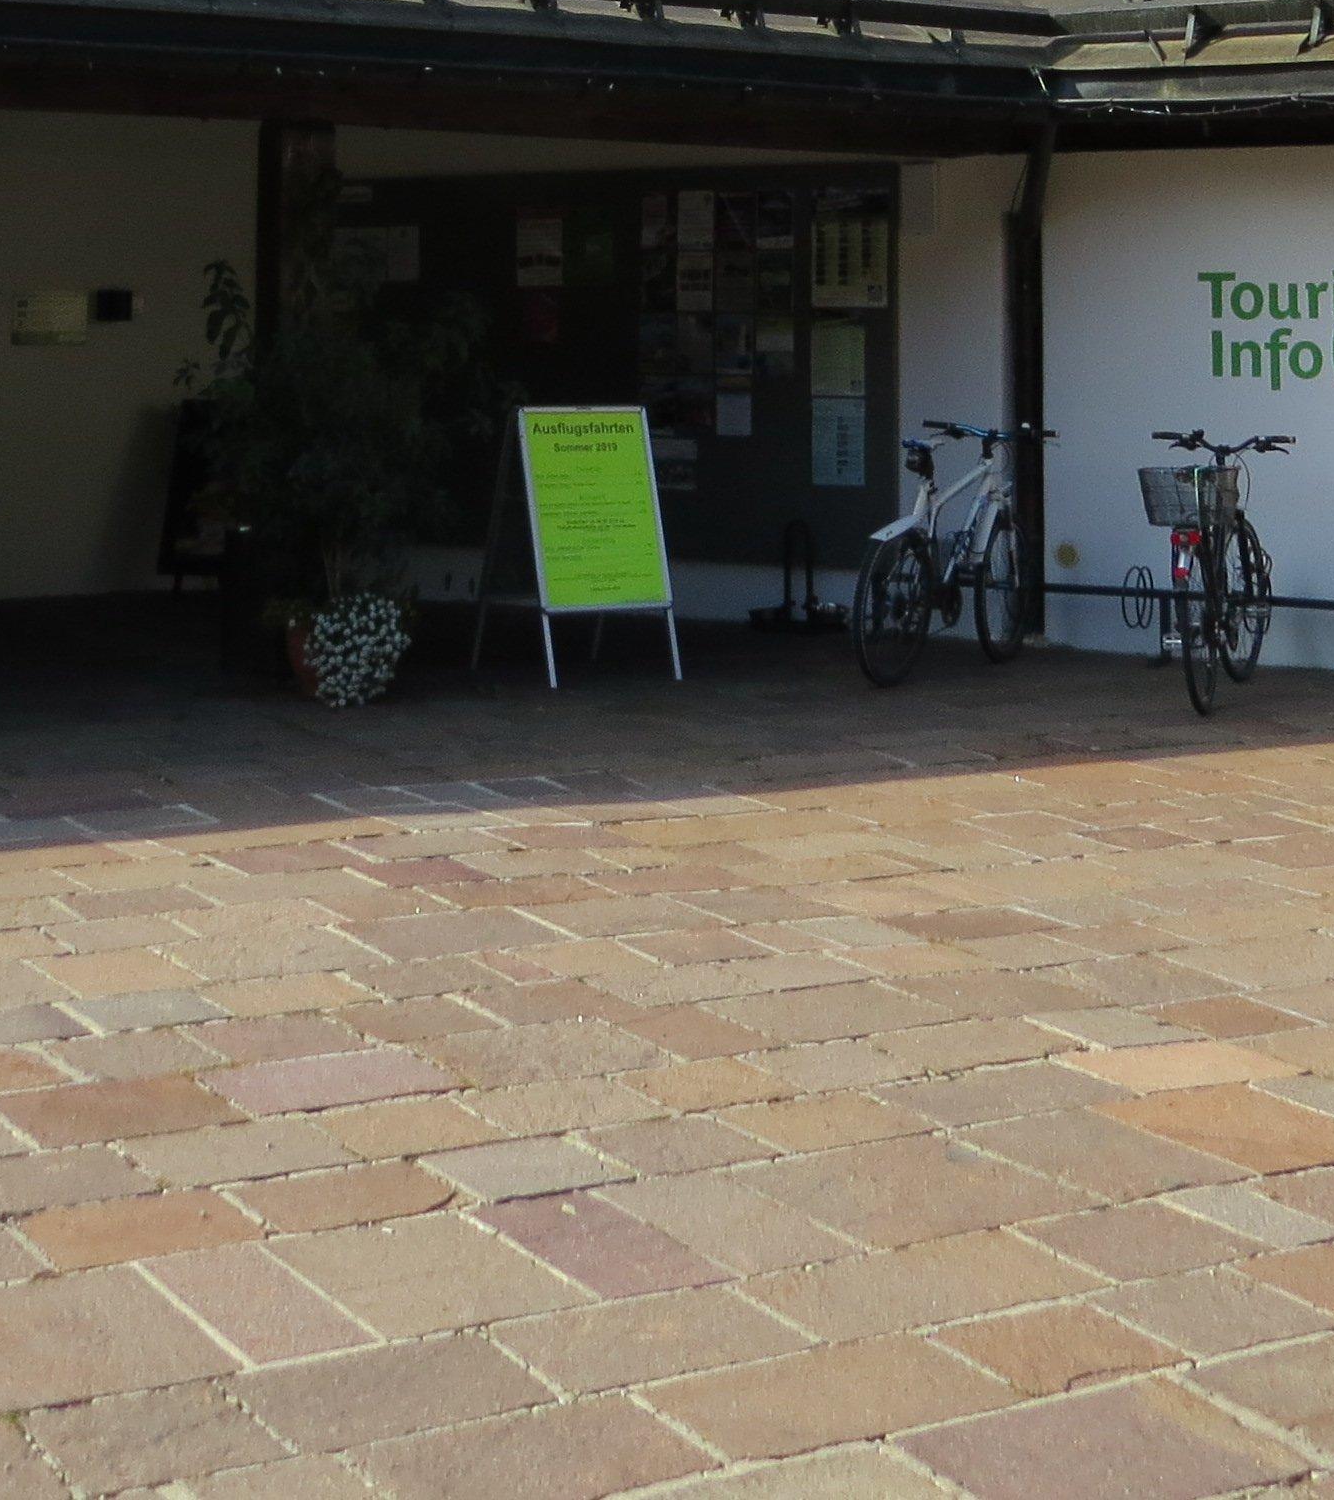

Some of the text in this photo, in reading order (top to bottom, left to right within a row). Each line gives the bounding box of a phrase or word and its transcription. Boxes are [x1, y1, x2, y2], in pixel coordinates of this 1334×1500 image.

[1211, 327, 1323, 391] Info
[532, 421, 635, 438] Ausflugsfahrten
[553, 442, 594, 453] Sommer
